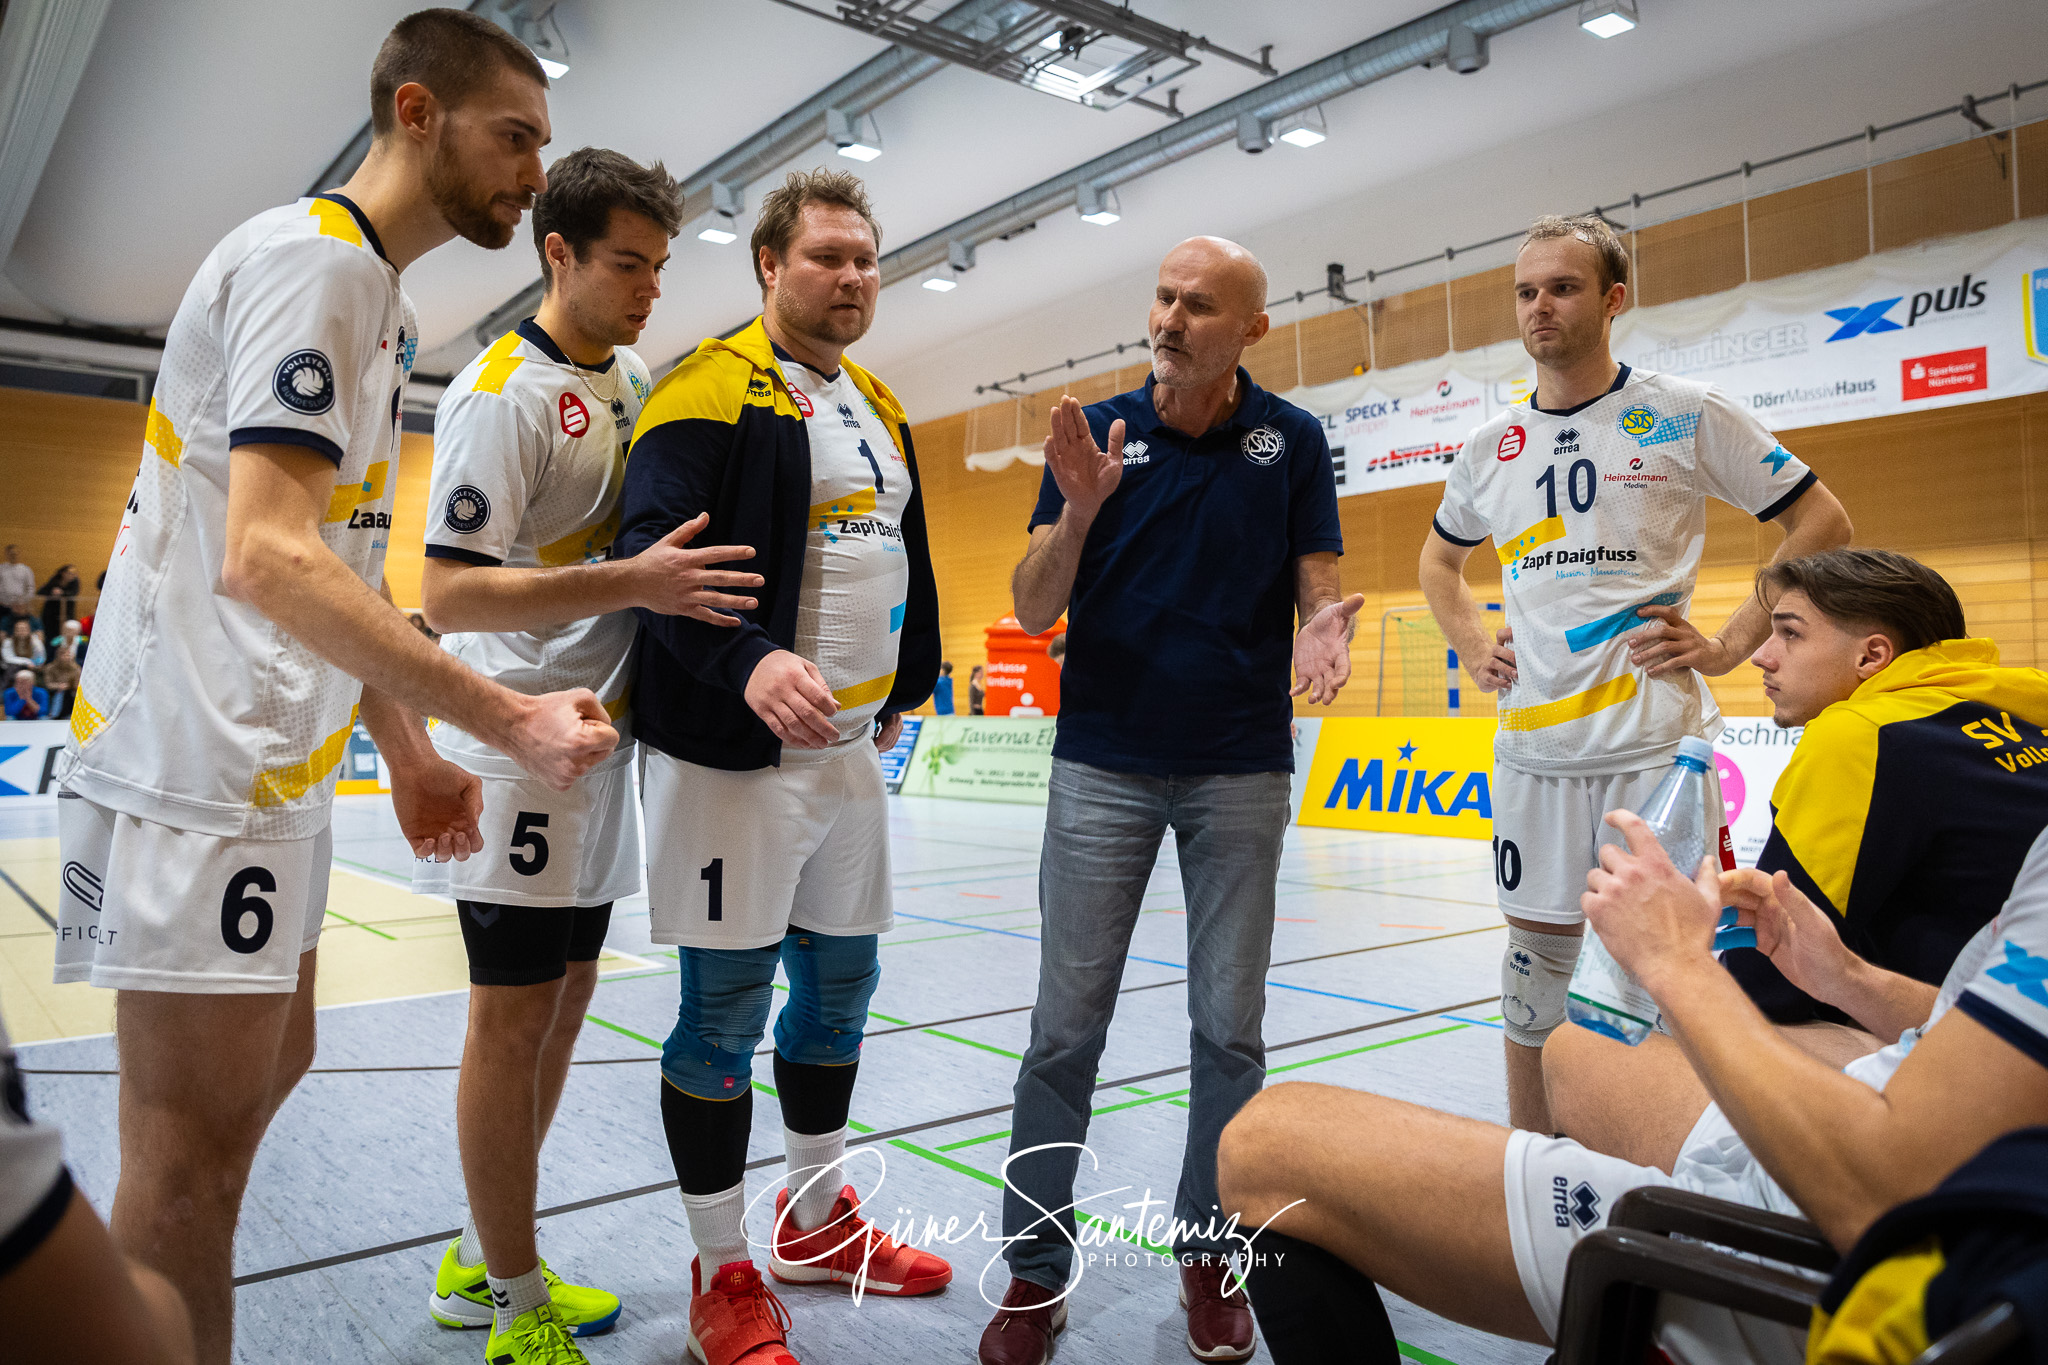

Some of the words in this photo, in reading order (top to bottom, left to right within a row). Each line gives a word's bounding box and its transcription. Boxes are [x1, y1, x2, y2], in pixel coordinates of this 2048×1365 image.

[1907, 273, 1987, 327] puls
[283, 356, 332, 382] VOLLEYBALL
[1928, 362, 1977, 376] Sparkasse
[1928, 373, 1975, 388] Nürnberg
[281, 385, 330, 408] BUNDESLIGA
[1753, 378, 1877, 409] DörrMassivHaus
[1346, 402, 1388, 424] SPECK
[1410, 397, 1480, 418] Heinzelmann
[615, 416, 631, 430] errea
[843, 419, 861, 429] errea
[1122, 454, 1150, 466] errea
[1553, 443, 1580, 455] errea
[857, 438, 886, 494] 1
[1603, 472, 1668, 482] Heinzelmann
[1535, 458, 1597, 518] 10
[450, 491, 485, 509] VOLLEYBALL
[837, 519, 876, 537] Zapf
[1522, 551, 1553, 570] Zapf
[1556, 546, 1638, 566] Daigfuss
[960, 727, 1031, 745] Taverna
[1961, 711, 2023, 750] SV
[509, 811, 550, 876] 5
[1493, 835, 1522, 891] 10
[700, 858, 723, 921] 1
[220, 866, 277, 955] 6
[1509, 961, 1531, 977] errea
[1553, 1176, 1570, 1228] errea
